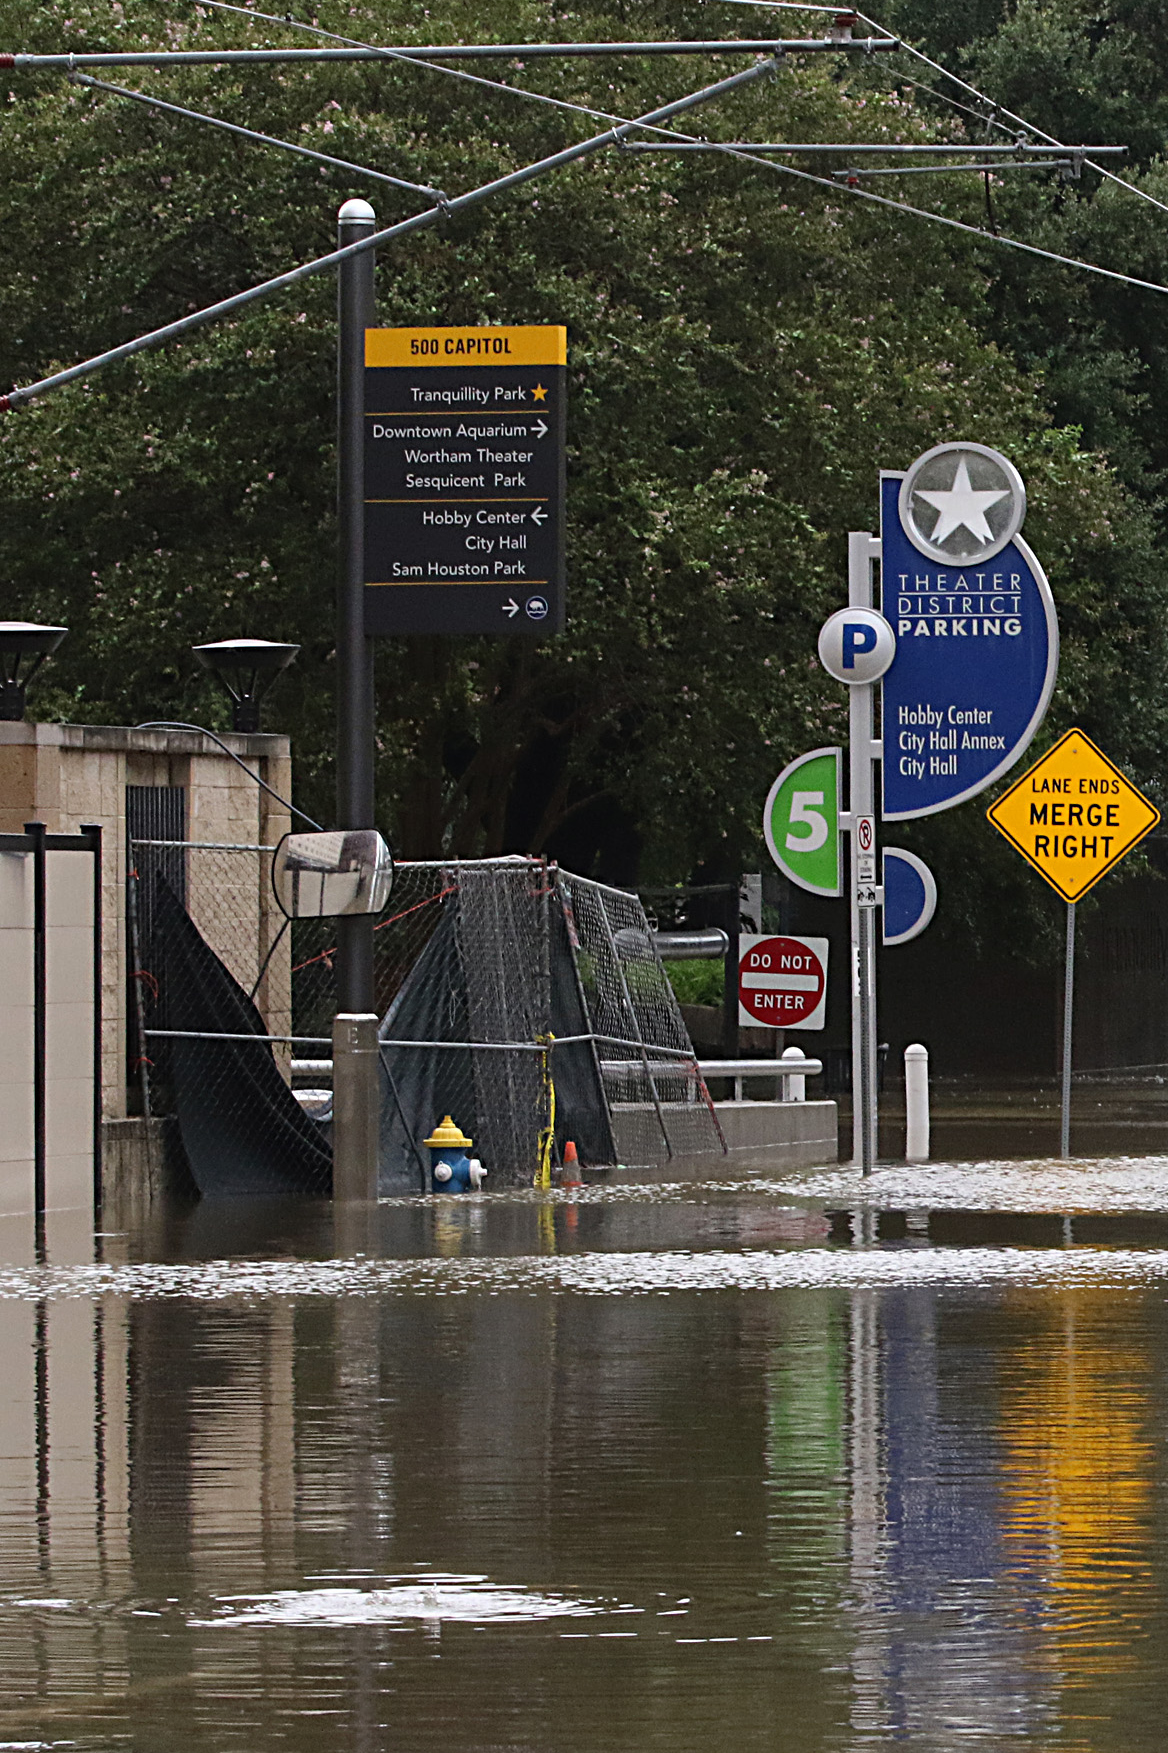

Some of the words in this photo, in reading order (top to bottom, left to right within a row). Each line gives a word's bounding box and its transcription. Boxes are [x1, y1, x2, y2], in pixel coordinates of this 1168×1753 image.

[410, 339, 439, 355] 500
[444, 337, 512, 354] CAPITOL
[410, 387, 490, 405] Tranquillity
[494, 386, 527, 401] Park
[373, 424, 452, 439] Downtown
[456, 423, 527, 441] Aquarium
[404, 448, 472, 464] Wortham
[477, 448, 533, 463] Theater
[405, 474, 485, 491] Sesquicent
[494, 473, 527, 488] Park
[423, 510, 472, 528] Hobby
[476, 510, 527, 525] Center
[465, 535, 494, 554] City
[499, 534, 528, 549] Hall
[392, 562, 423, 577] Sam
[427, 561, 490, 576] Houston
[494, 561, 526, 576] Park
[898, 573, 1022, 592] THEATER
[898, 596, 1022, 615] DISTRICT
[898, 618, 1023, 637] PARKING
[842, 623, 878, 669] P
[898, 705, 944, 730] Hobby
[948, 704, 993, 726] Center
[898, 730, 926, 755] City
[930, 729, 958, 751] Hall
[961, 730, 1006, 751] Annex
[898, 755, 926, 780] City
[930, 754, 958, 776] Hall
[1032, 778, 1072, 793] LANE
[1079, 779, 1120, 795] ENDS
[785, 791, 829, 852] 5
[1030, 803, 1120, 827] MERGE
[1035, 835, 1115, 858] RIGHT
[750, 953, 772, 969] DO
[781, 955, 813, 970] NOT
[754, 994, 805, 1010] ENTER
